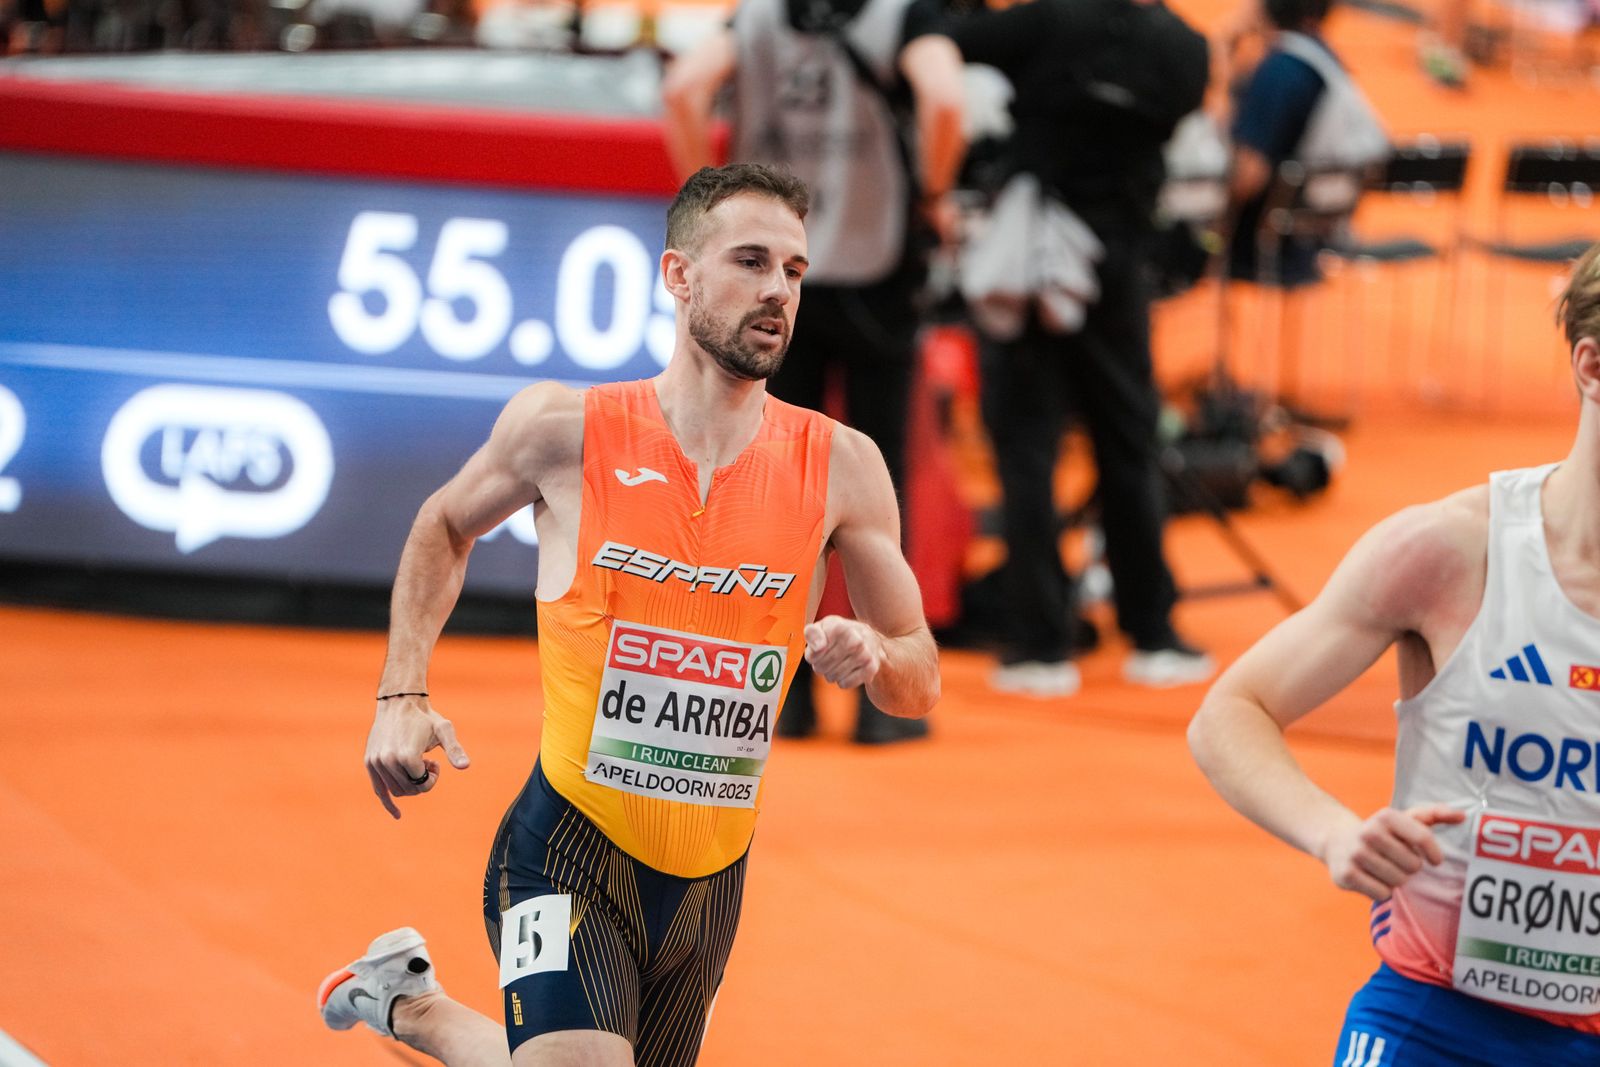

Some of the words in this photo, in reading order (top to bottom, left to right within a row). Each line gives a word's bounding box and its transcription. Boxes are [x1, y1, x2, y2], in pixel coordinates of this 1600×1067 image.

[591, 540, 796, 598] ESPAÑA
[614, 633, 745, 682] SPAR
[601, 680, 646, 724] de
[654, 691, 769, 742] ARRIBA
[631, 745, 637, 758] I
[640, 748, 679, 766] RUN
[1463, 721, 1600, 794] NOR
[593, 762, 716, 798] APELDOORN
[717, 782, 753, 800] 2025
[1481, 819, 1600, 871] SPA
[516, 910, 543, 969] 5
[1505, 946, 1512, 962] I
[1516, 948, 1562, 970] RUN
[511, 992, 524, 1026] ESP
[1462, 967, 1600, 1005] APELDOOR
